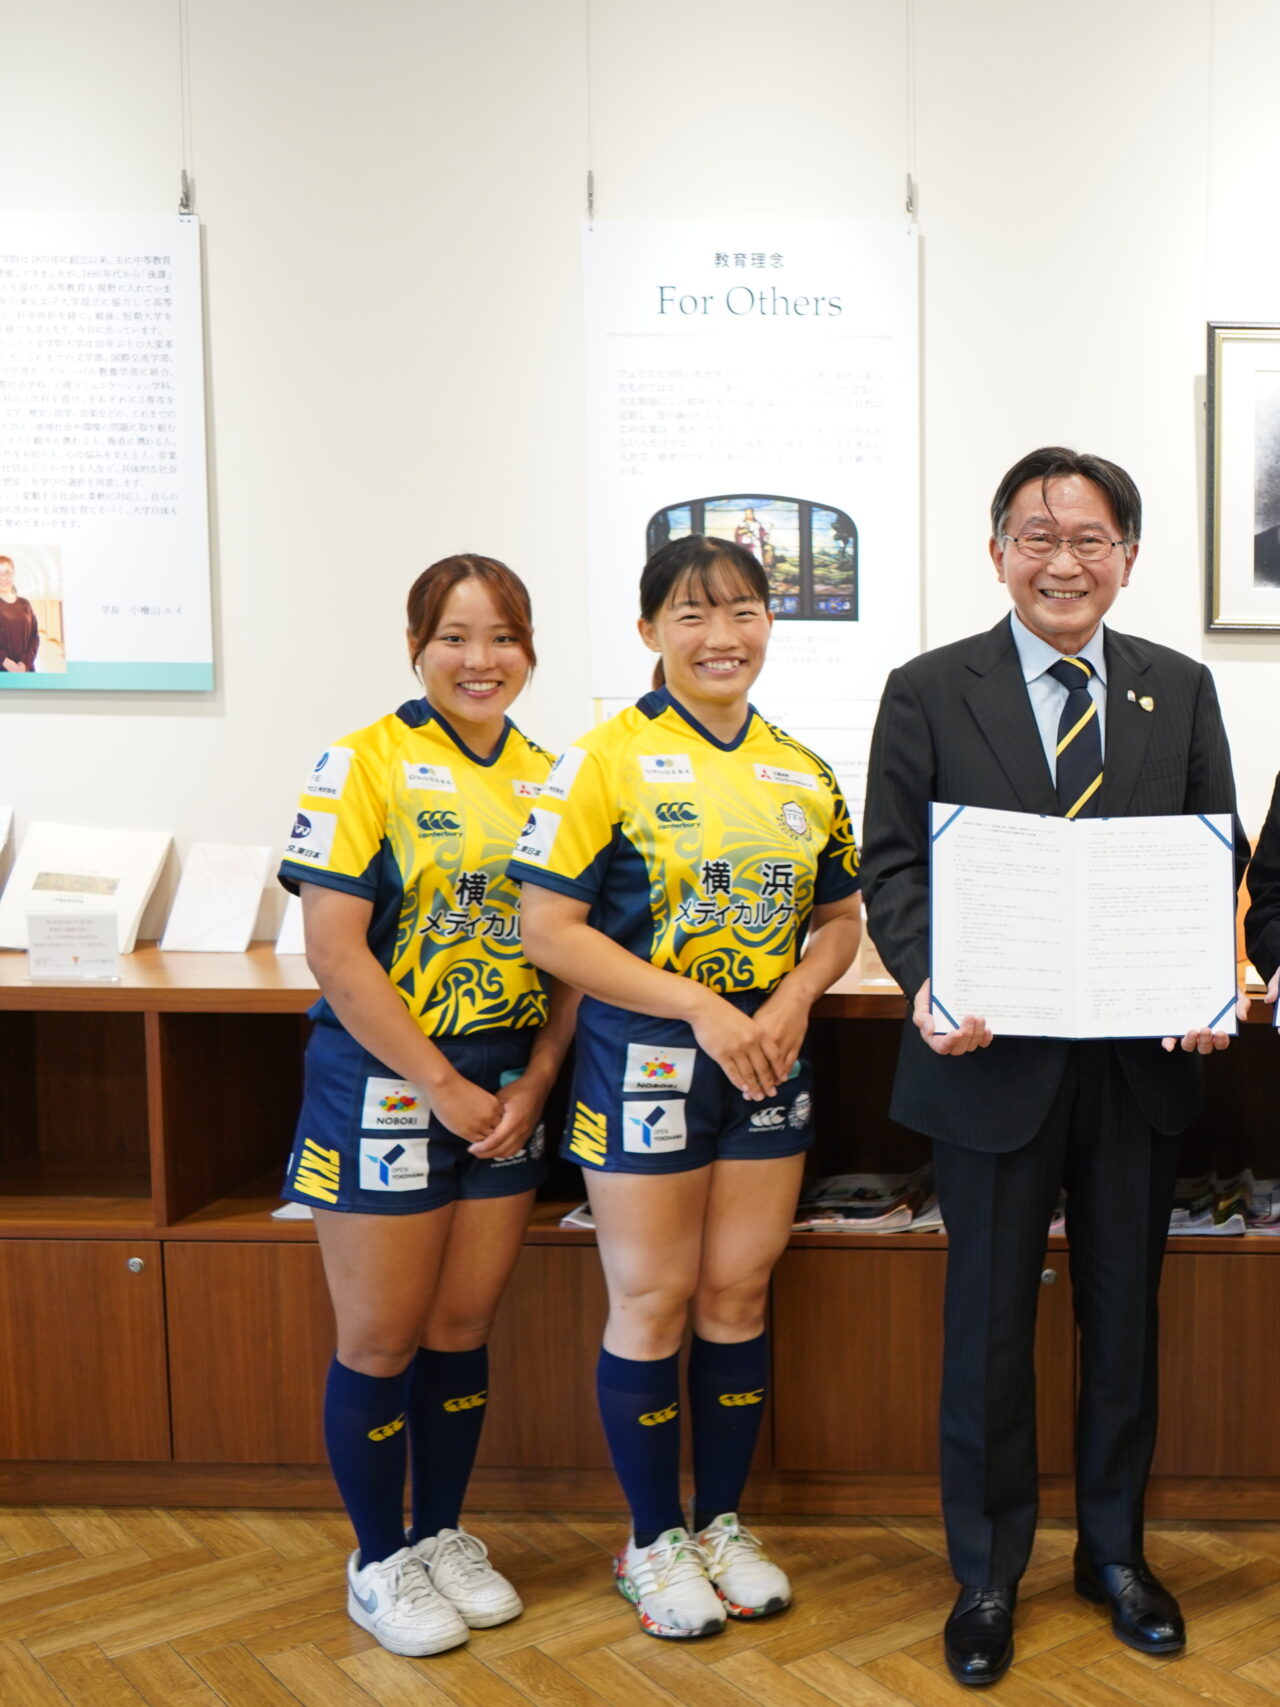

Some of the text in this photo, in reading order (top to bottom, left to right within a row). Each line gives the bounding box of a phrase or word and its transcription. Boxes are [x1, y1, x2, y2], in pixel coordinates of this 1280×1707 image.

[714, 252, 784, 269] 教育理念
[656, 285, 842, 316] For Others
[657, 821, 701, 830] canterbury
[418, 830, 463, 839] canterbury
[701, 861, 795, 898] 横浜
[637, 1081, 678, 1090] NOBORI
[376, 1116, 418, 1126] NOBORI
[391, 1166, 409, 1174] OPEN
[391, 1172, 425, 1181] YOKOHAMA
